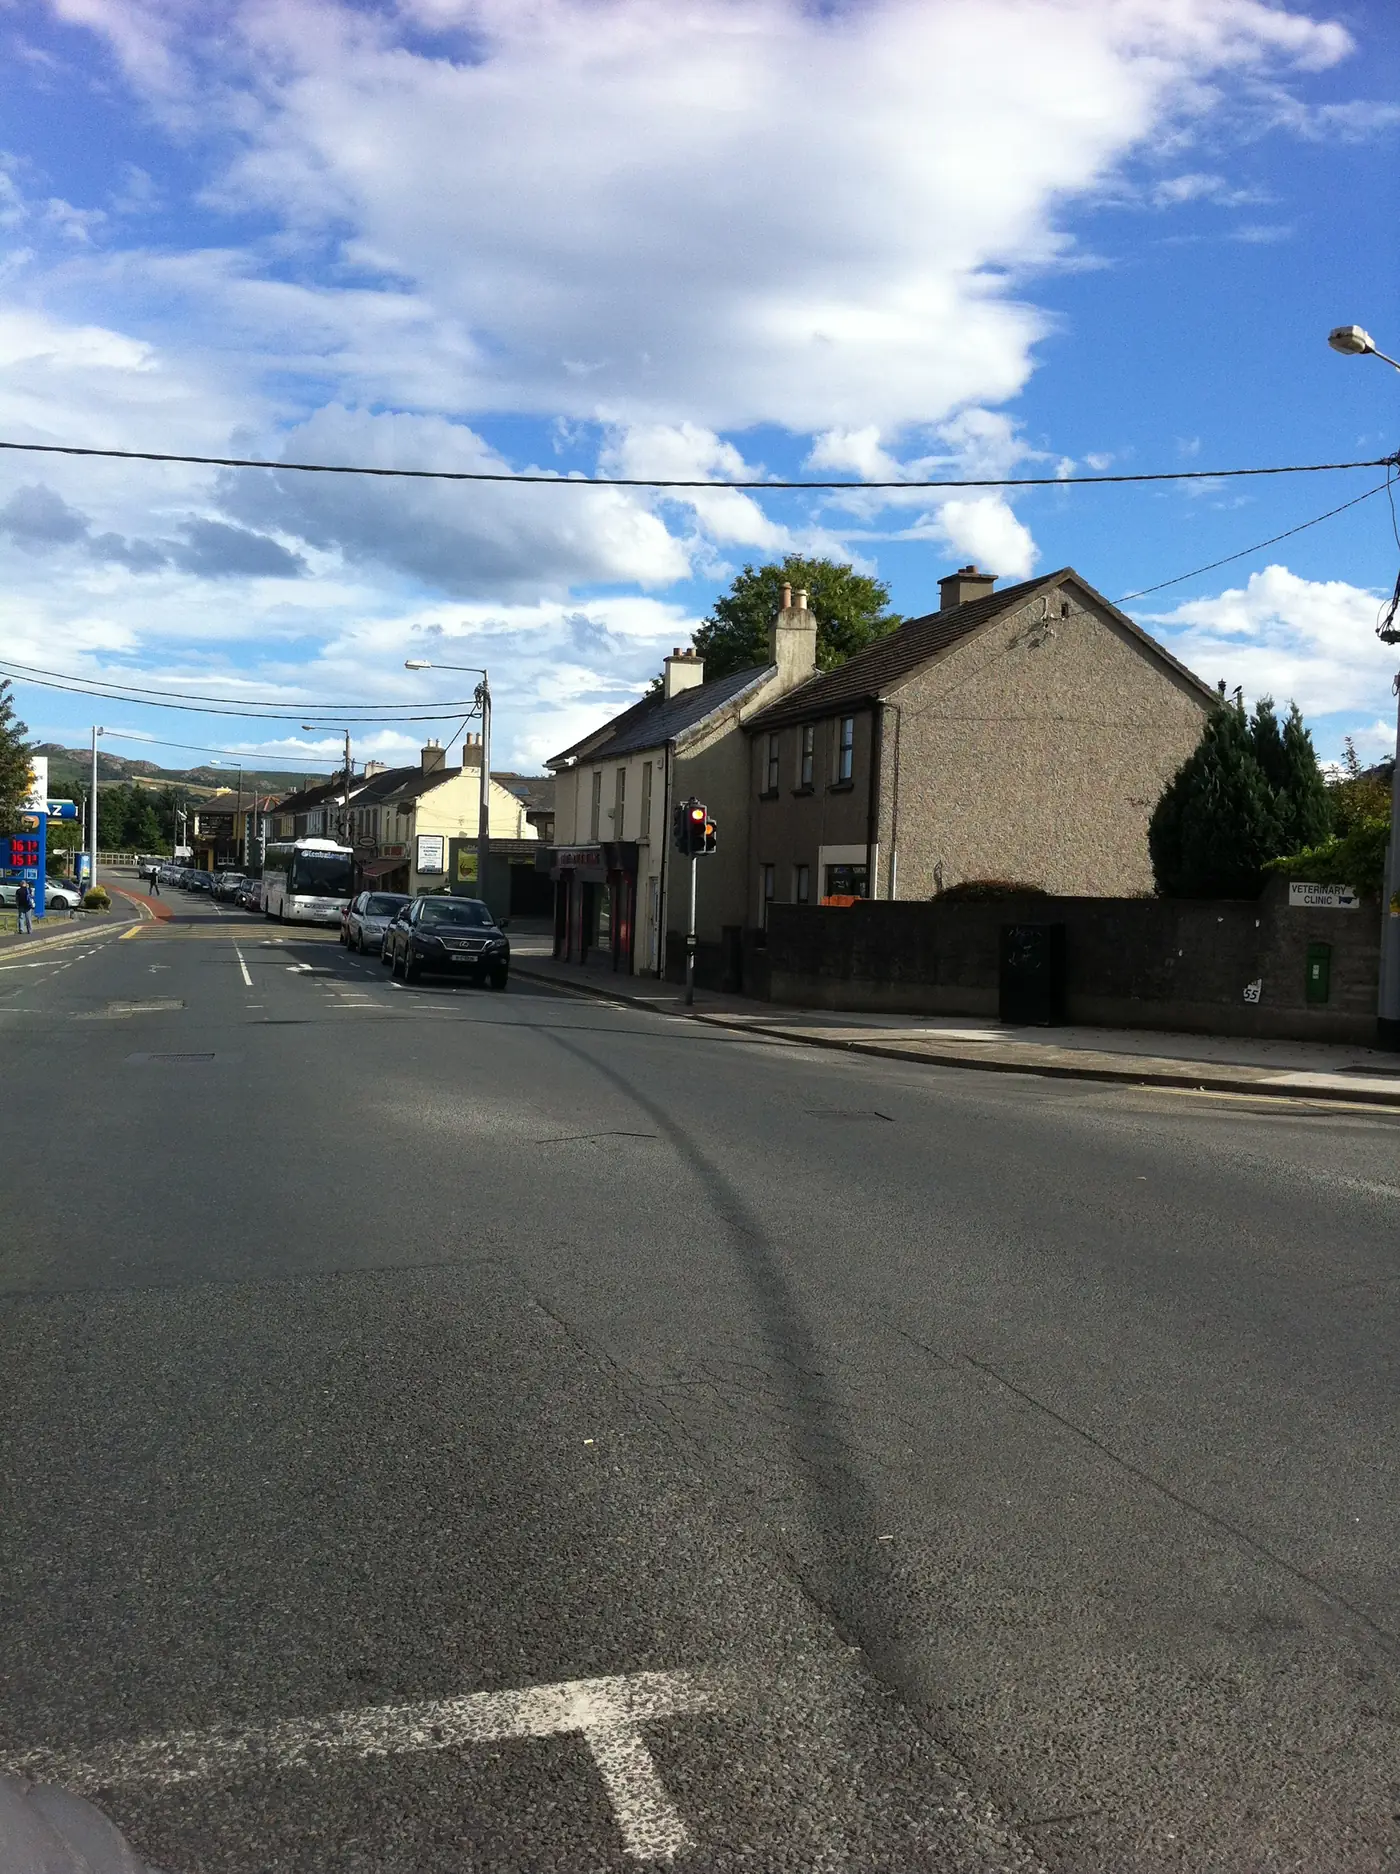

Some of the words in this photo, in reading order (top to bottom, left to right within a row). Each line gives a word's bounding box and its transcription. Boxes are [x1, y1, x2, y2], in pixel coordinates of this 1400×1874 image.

[1291, 884, 1347, 895] VETERINARY
[1303, 895, 1333, 905] CLINIC
[1243, 989, 1259, 1000] 55
